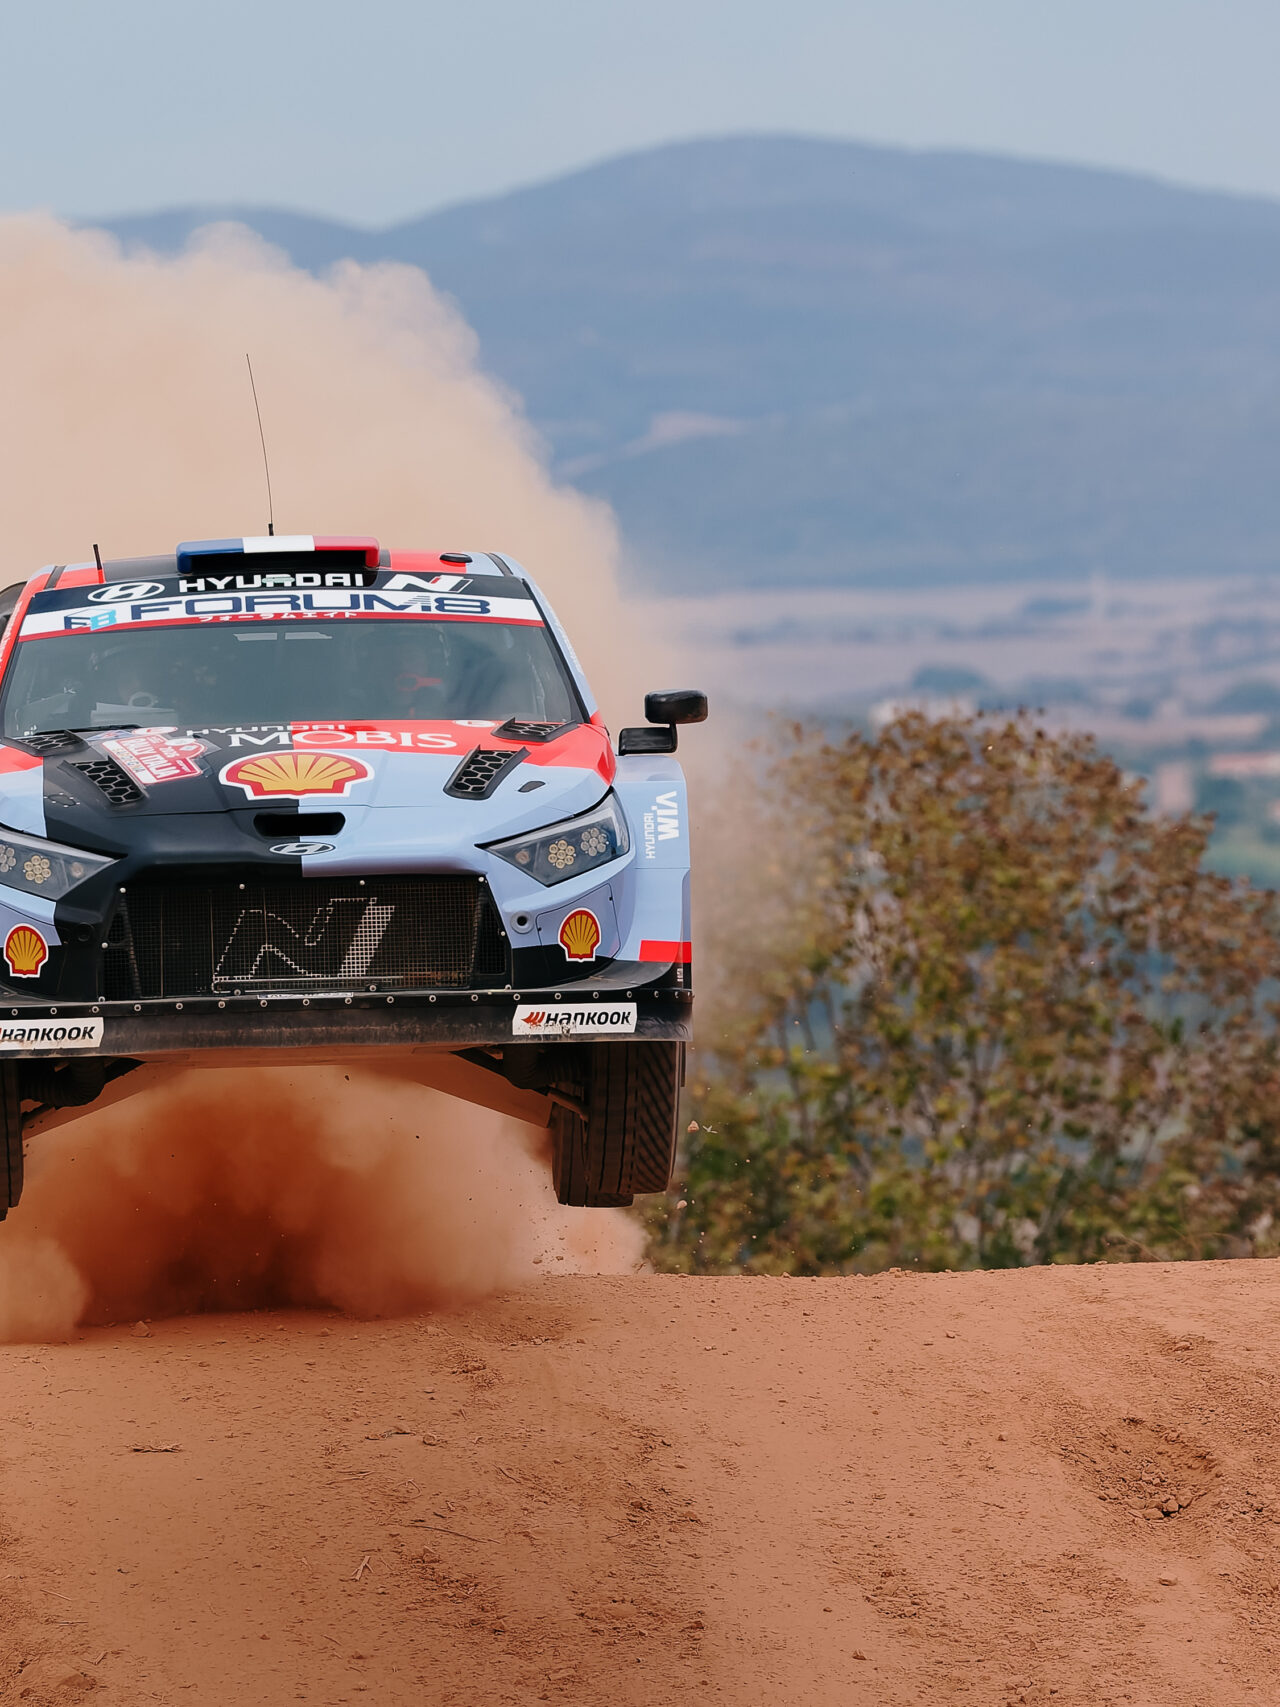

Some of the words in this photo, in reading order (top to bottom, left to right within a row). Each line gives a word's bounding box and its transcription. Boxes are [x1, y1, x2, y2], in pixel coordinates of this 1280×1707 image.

[179, 573, 363, 593] HYUNDAI
[131, 594, 491, 620] FORUM8
[198, 612, 358, 623] フォーラムエイト
[186, 724, 346, 736] HYUNDAI
[228, 731, 457, 748] MOBIS
[651, 790, 680, 841] WIA
[643, 812, 656, 860] HYUNDAI
